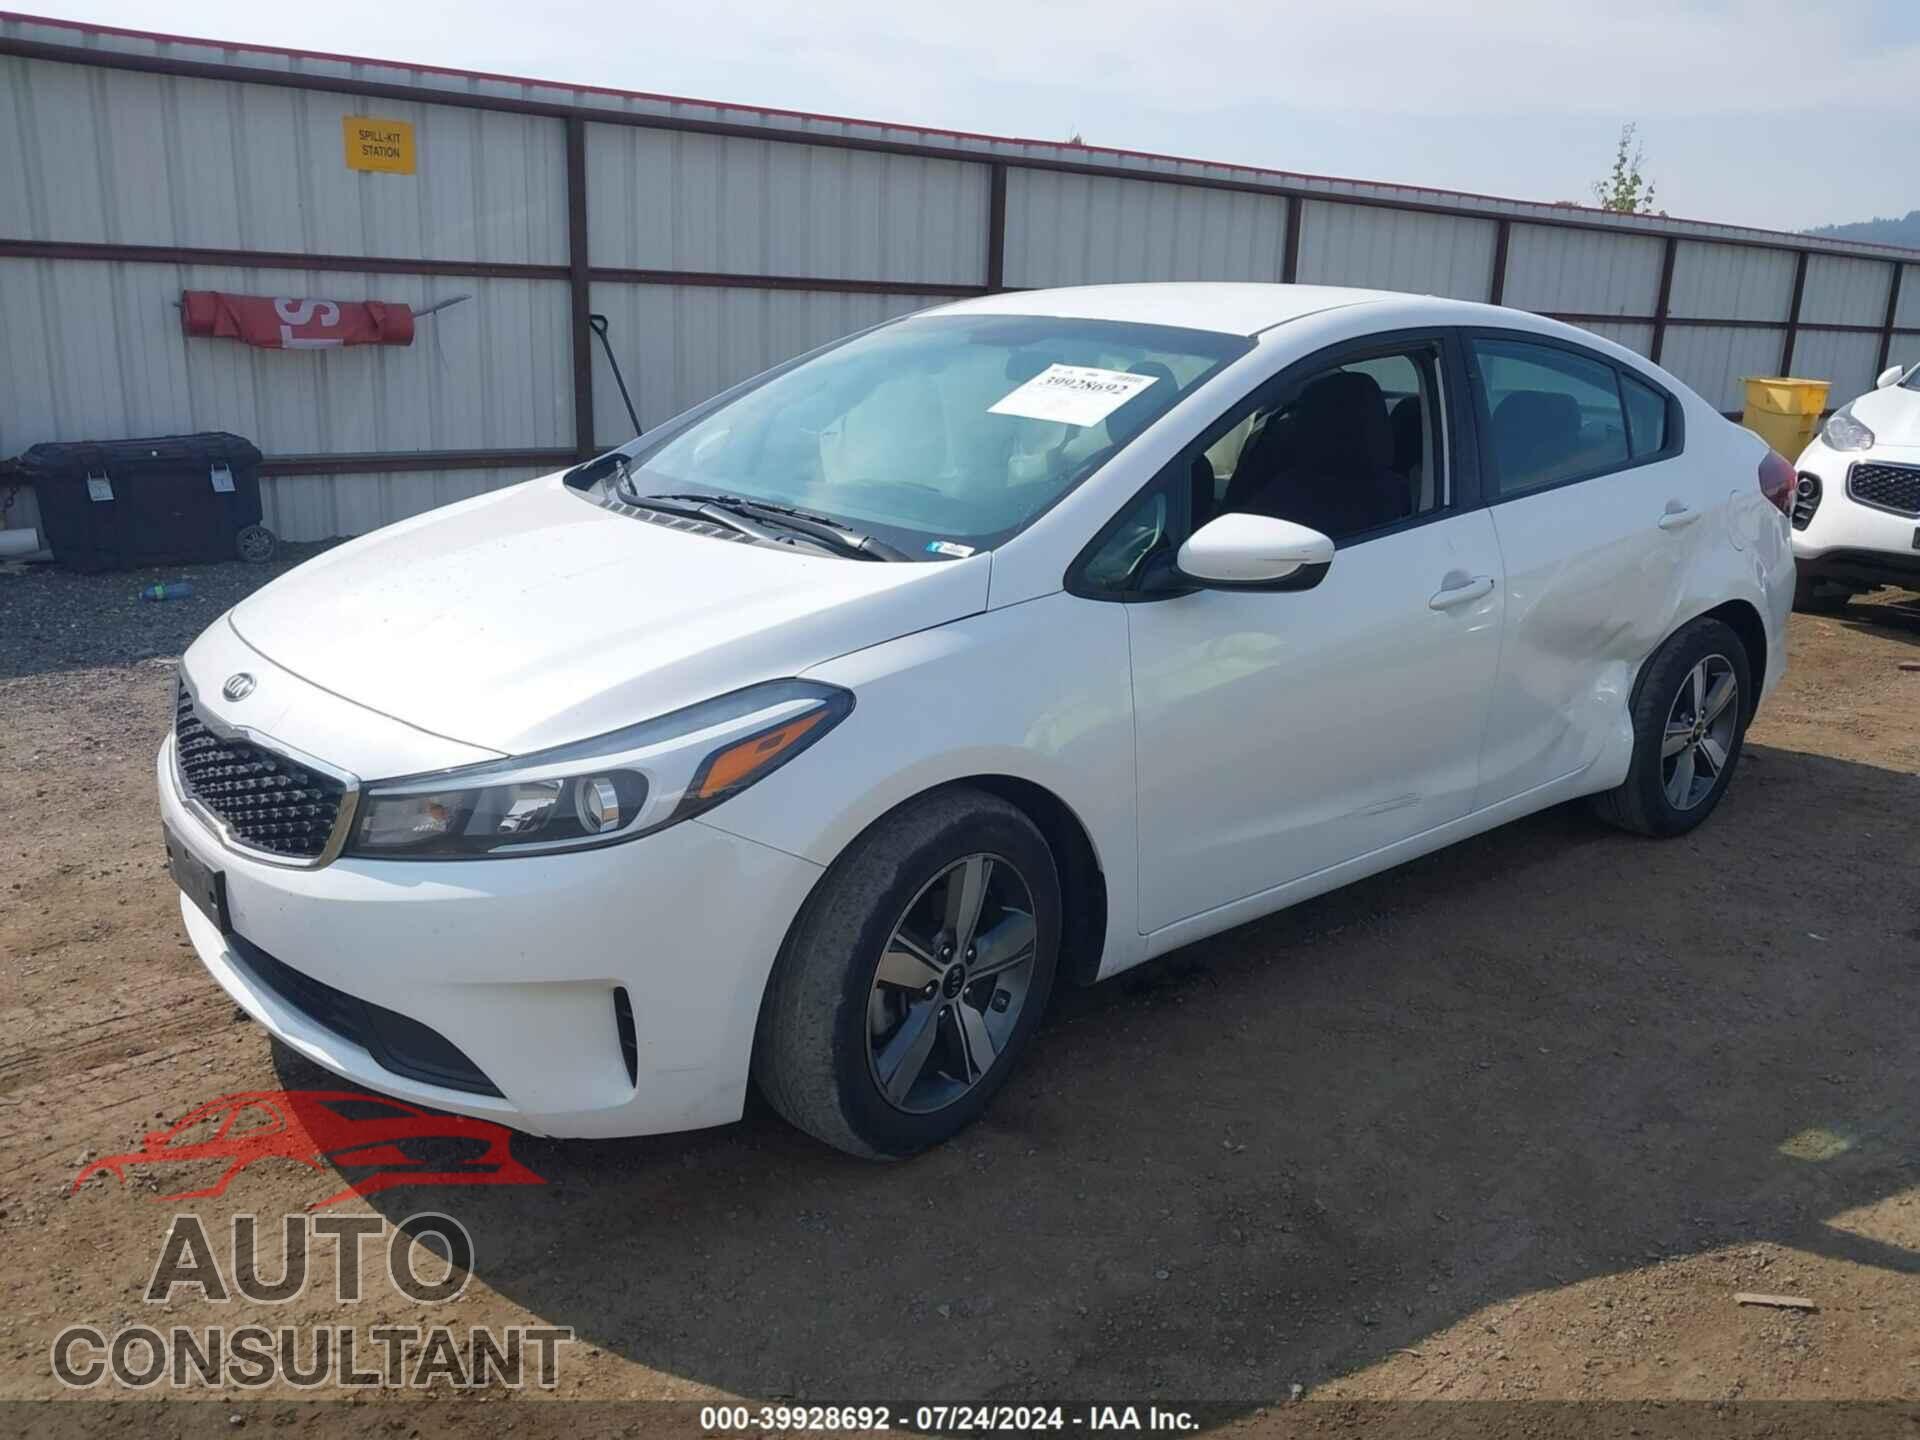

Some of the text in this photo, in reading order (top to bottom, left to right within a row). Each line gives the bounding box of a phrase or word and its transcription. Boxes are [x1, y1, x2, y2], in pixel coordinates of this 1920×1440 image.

[358, 128, 401, 144] SPILL-KIT
[361, 144, 401, 158] STATION
[1038, 374, 1130, 396] 39928692
